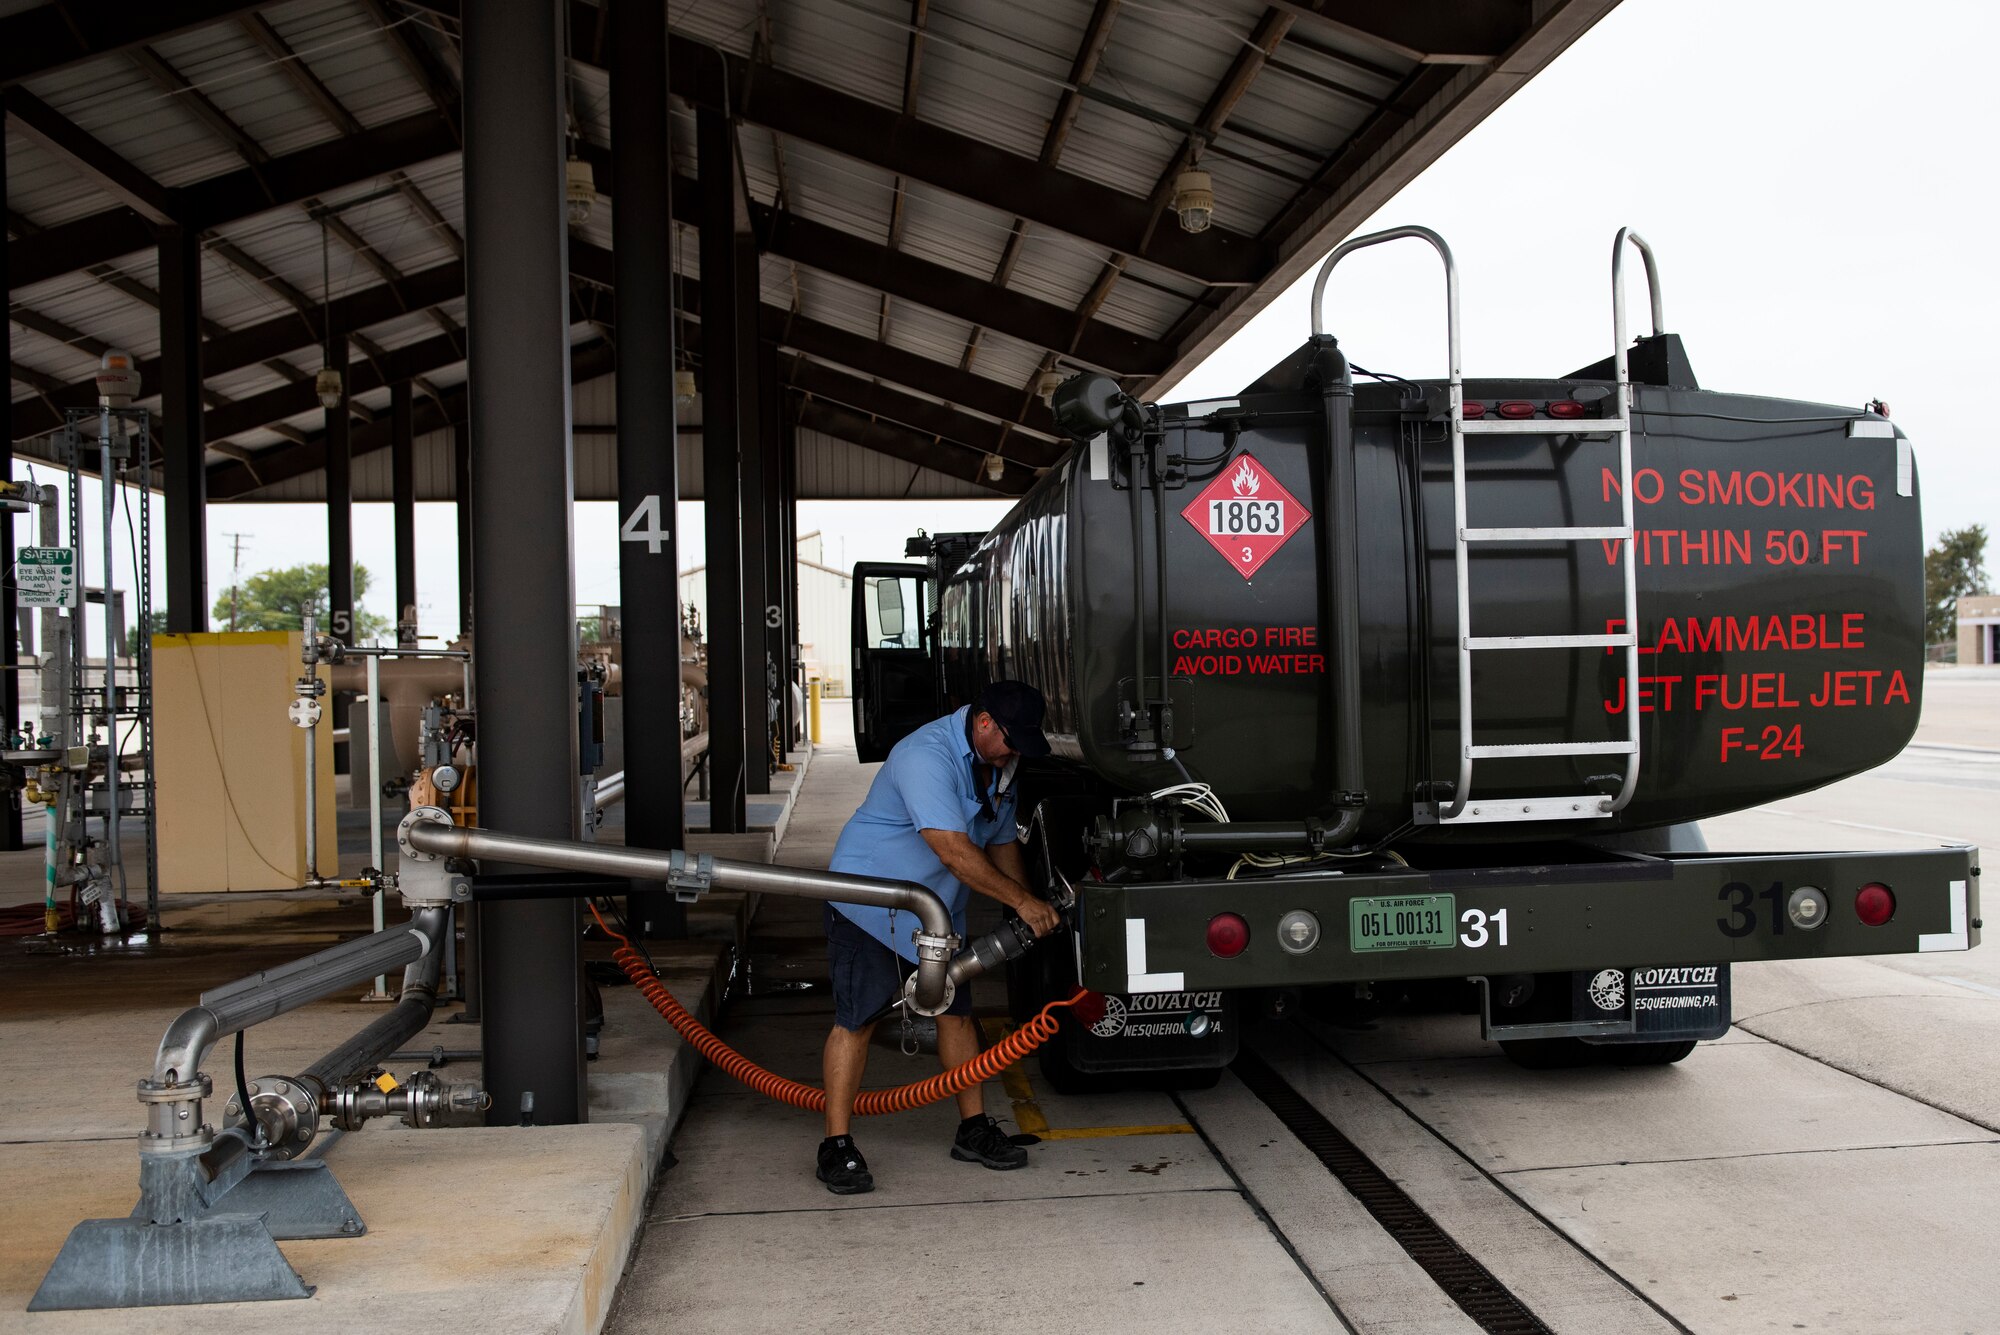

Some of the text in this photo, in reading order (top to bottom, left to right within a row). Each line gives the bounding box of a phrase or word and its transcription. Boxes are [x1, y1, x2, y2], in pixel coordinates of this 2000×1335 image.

[1602, 467, 1875, 511] NO SMOKING
[620, 495, 670, 554] 4
[1212, 501, 1281, 534] 1863
[23, 549, 69, 560] SAFETY
[1241, 547, 1253, 563] 3
[1602, 529, 1868, 566] WITHIN 50 FT
[332, 610, 350, 635] 5
[765, 605, 782, 629] 3
[1173, 627, 1317, 650] CARGO FIRE
[1173, 655, 1325, 676] AVOID WATER
[1604, 675, 1682, 714] JET
[1695, 673, 1800, 711] FUEL
[1720, 724, 1805, 763] F-24
[1380, 900, 1393, 908] U.S.
[1405, 899, 1425, 907] FORCE
[1716, 881, 1783, 938] 31
[1460, 908, 1508, 948] 31
[1635, 966, 1718, 986] KOVATCH
[1128, 991, 1222, 1011] KOVATCH
